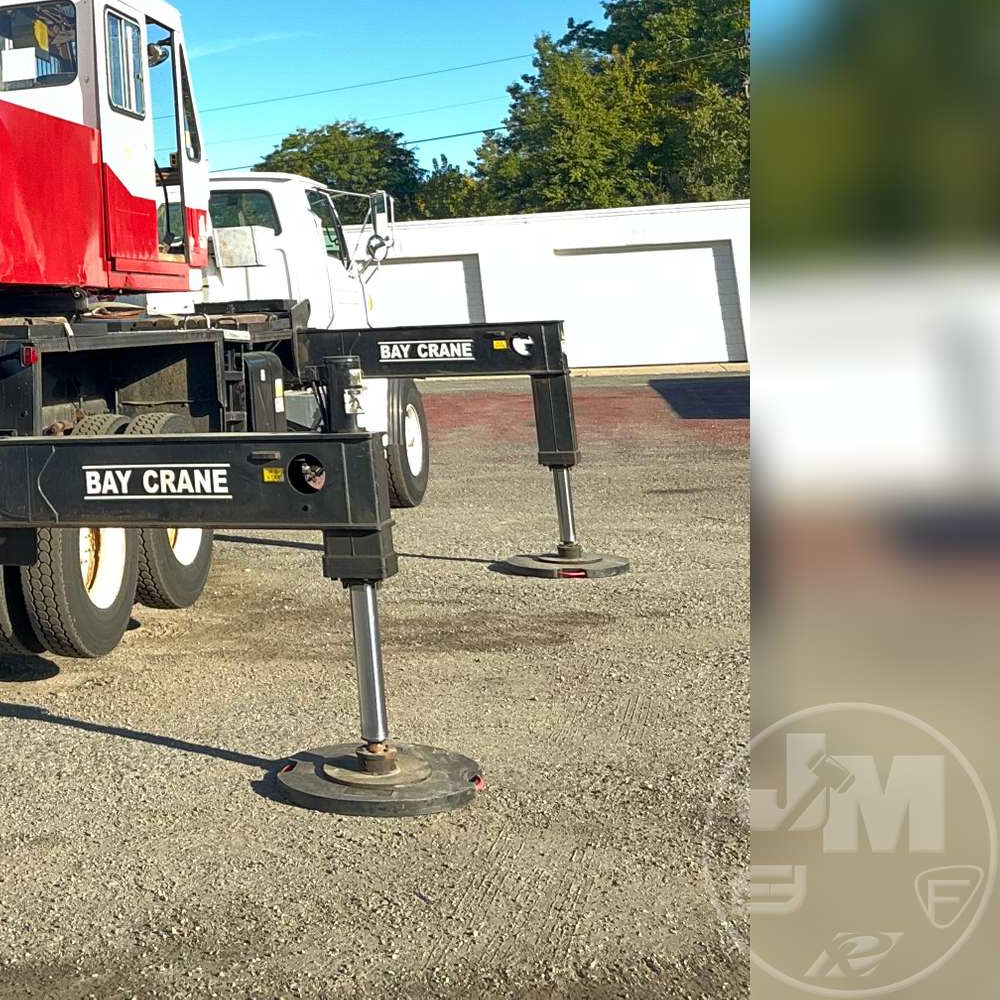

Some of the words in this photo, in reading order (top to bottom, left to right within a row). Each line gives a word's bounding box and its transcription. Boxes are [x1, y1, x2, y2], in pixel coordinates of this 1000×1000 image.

[379, 344, 411, 359] BAY
[416, 342, 473, 358] CRANE
[85, 469, 132, 495] BAY
[142, 468, 230, 494] CRANE
